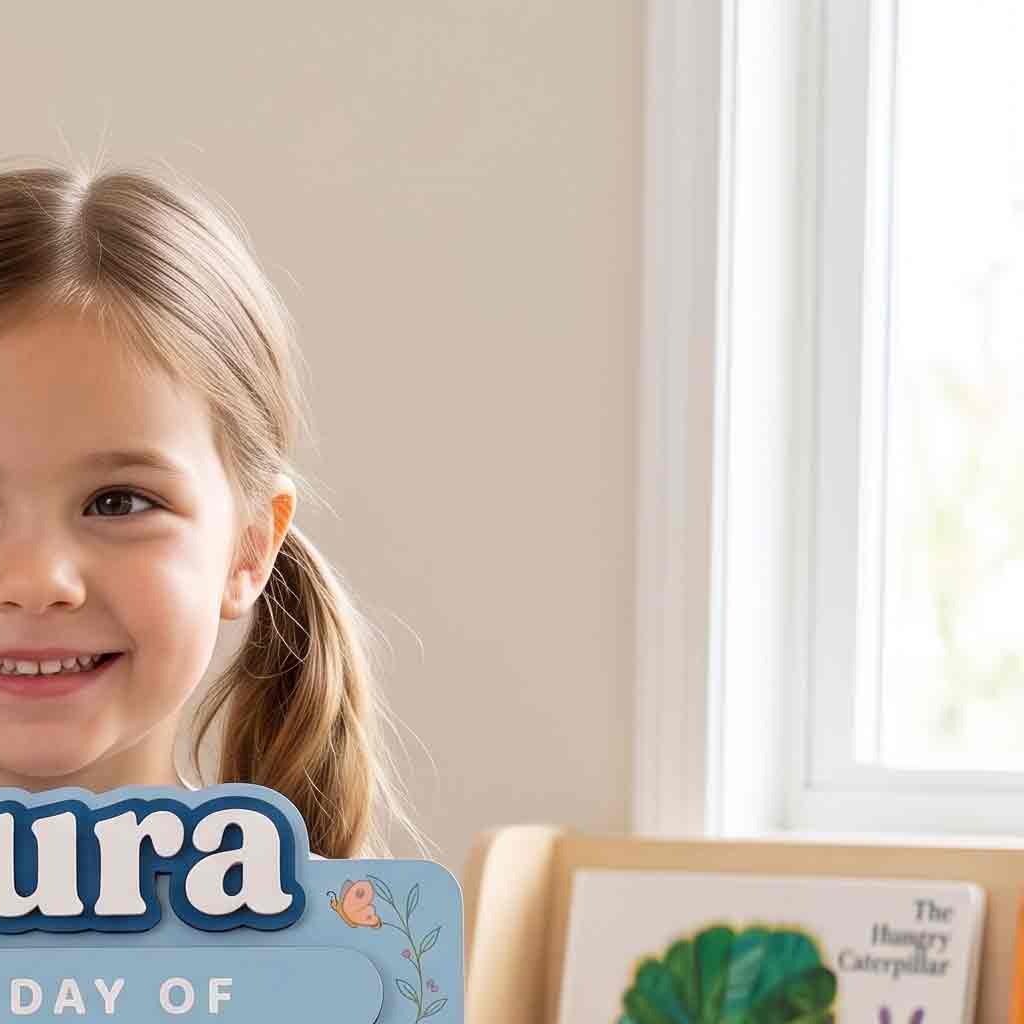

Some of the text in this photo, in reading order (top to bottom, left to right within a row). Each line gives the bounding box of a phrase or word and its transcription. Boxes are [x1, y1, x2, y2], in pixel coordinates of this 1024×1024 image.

[914, 899, 954, 923] The
[870, 921, 950, 952] Hungry
[836, 947, 950, 980] Caterpillar
[10, 978, 126, 1017] DAY
[159, 977, 234, 1016] OF
